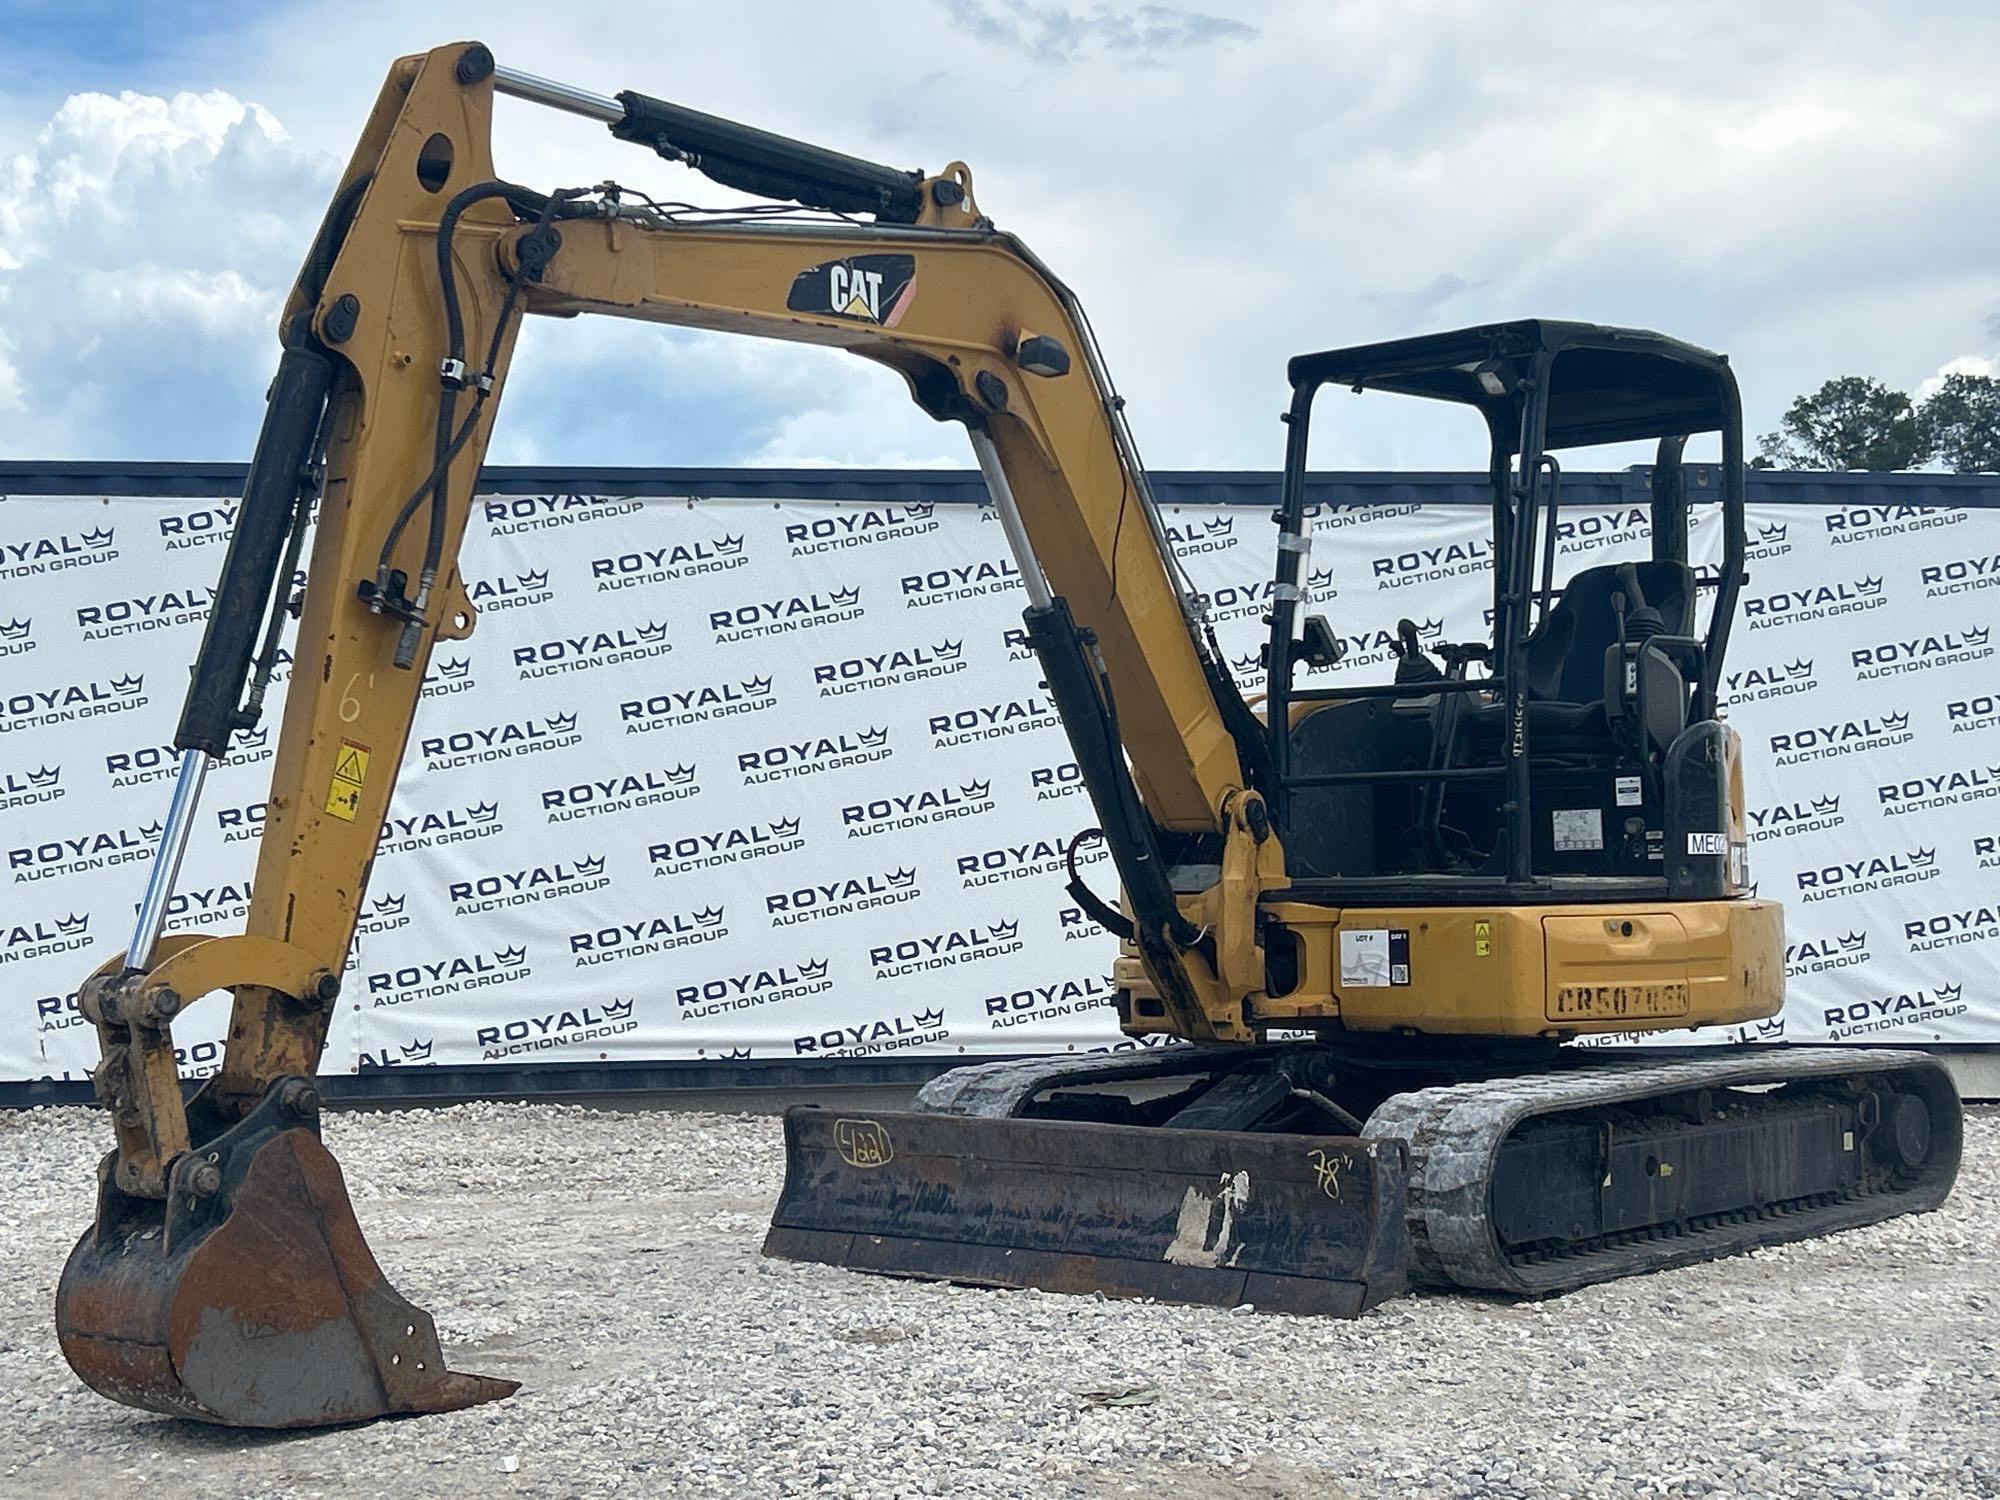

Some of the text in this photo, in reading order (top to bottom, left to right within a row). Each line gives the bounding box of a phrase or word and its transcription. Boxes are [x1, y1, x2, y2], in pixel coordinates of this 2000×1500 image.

[831, 265, 882, 319] CAT
[159, 507, 238, 536] ROY
[490, 502, 644, 537] AUCTION GROUP
[786, 509, 906, 543] ROYAL
[1360, 504, 1422, 522] GROUP
[1555, 508, 1648, 541] ROYA
[1831, 513, 1968, 545] AUCTION GROUP
[792, 522, 939, 557] AUCTION GROUP
[1177, 538, 1238, 557] GROUP
[1559, 530, 1636, 555] AUCTION
[50, 550, 119, 571] GROUP
[592, 543, 714, 578] ROYAL
[598, 557, 748, 592] AUCTION GROUP
[1373, 541, 1486, 577] ROYAL
[902, 560, 1019, 595] ROYAL
[1378, 567, 1455, 591] AUCTION
[77, 590, 206, 627] ROYAL
[487, 592, 553, 612] GROUP
[711, 596, 831, 630] ROYAL
[907, 585, 986, 608] AUCTION
[1743, 585, 1856, 617] ROYAL
[83, 617, 171, 641] AUCTION
[717, 609, 864, 644] AUCTION GROUP
[1749, 598, 1887, 630] AUCTION GROUP
[513, 630, 638, 667] ROYAL
[519, 645, 673, 681] AUCTION GROUP
[1852, 635, 1962, 667] ROYAL
[1858, 648, 1993, 680] AUCTION GROUP
[814, 649, 934, 683] ROYAL
[820, 662, 967, 697] AUCTION GROUP
[0, 682, 111, 717] OYAL
[422, 680, 475, 698] ROUP
[620, 685, 742, 720] ROYAL
[1758, 680, 1818, 700] GROUP
[0, 696, 149, 732] UCTION GROUP
[626, 699, 776, 734] AUCTION GROUP
[930, 700, 1047, 735] ROYAL
[422, 721, 547, 758] ROYAL
[935, 725, 1014, 748] AUCTION
[1770, 721, 1883, 753] ROYAL
[1776, 734, 1914, 766] AUCTION GROUP
[428, 736, 582, 772] AUCTION GROUP
[739, 737, 859, 771] ROYAL
[745, 750, 892, 785] AUCTION GROUP
[541, 773, 666, 810] ROYAL
[1878, 769, 1988, 803] ROYAL
[547, 788, 701, 824] AUCTION GROUP
[842, 790, 962, 824] ROYAL
[848, 803, 995, 838] AUCTION GROUP
[1884, 794, 1957, 816] AUCTION
[436, 825, 503, 845] GROUP
[1784, 816, 1844, 836] GROUP
[8, 829, 140, 869] ROYAL
[649, 827, 772, 862] ROYAL
[655, 841, 806, 876] AUCTION GROUP
[957, 838, 1069, 875] ROYAL
[15, 857, 104, 883] AUCTION
[450, 865, 575, 902] ROYAL
[963, 864, 1042, 889] AUCTION
[1796, 857, 1909, 889] ROYAL
[1802, 870, 1940, 902] AUCTION GROUP
[456, 880, 610, 916] AUCTION GROUP
[767, 878, 887, 912] ROYAL
[773, 891, 920, 926] AUCTION GROUP
[24, 936, 94, 959] GROUP
[569, 915, 694, 952] ROYAL
[575, 930, 729, 966] AUCTION GROUP
[870, 930, 990, 964] ROYAL
[1355, 934, 1368, 942] LOT
[1910, 929, 1984, 952] AUCTION
[368, 956, 496, 993] ROYAL
[876, 943, 1023, 978] AUCTION GROUP
[1812, 952, 1870, 972] GROUP
[375, 970, 531, 1007] AUCTION GROUP
[676, 969, 798, 1004] ROYAL
[682, 983, 832, 1018] AUCTION GROUP
[984, 977, 1103, 1016] ROYAL
[991, 1006, 1072, 1029] AUCTION
[1823, 993, 1936, 1025] ROYAL
[1829, 1006, 1967, 1038] AUCTION GROUP
[478, 1008, 603, 1045] ROYAL
[484, 1023, 638, 1059] AUCTION GROUP
[794, 1017, 914, 1055] ROYAL
[885, 1030, 949, 1051] GROUP
